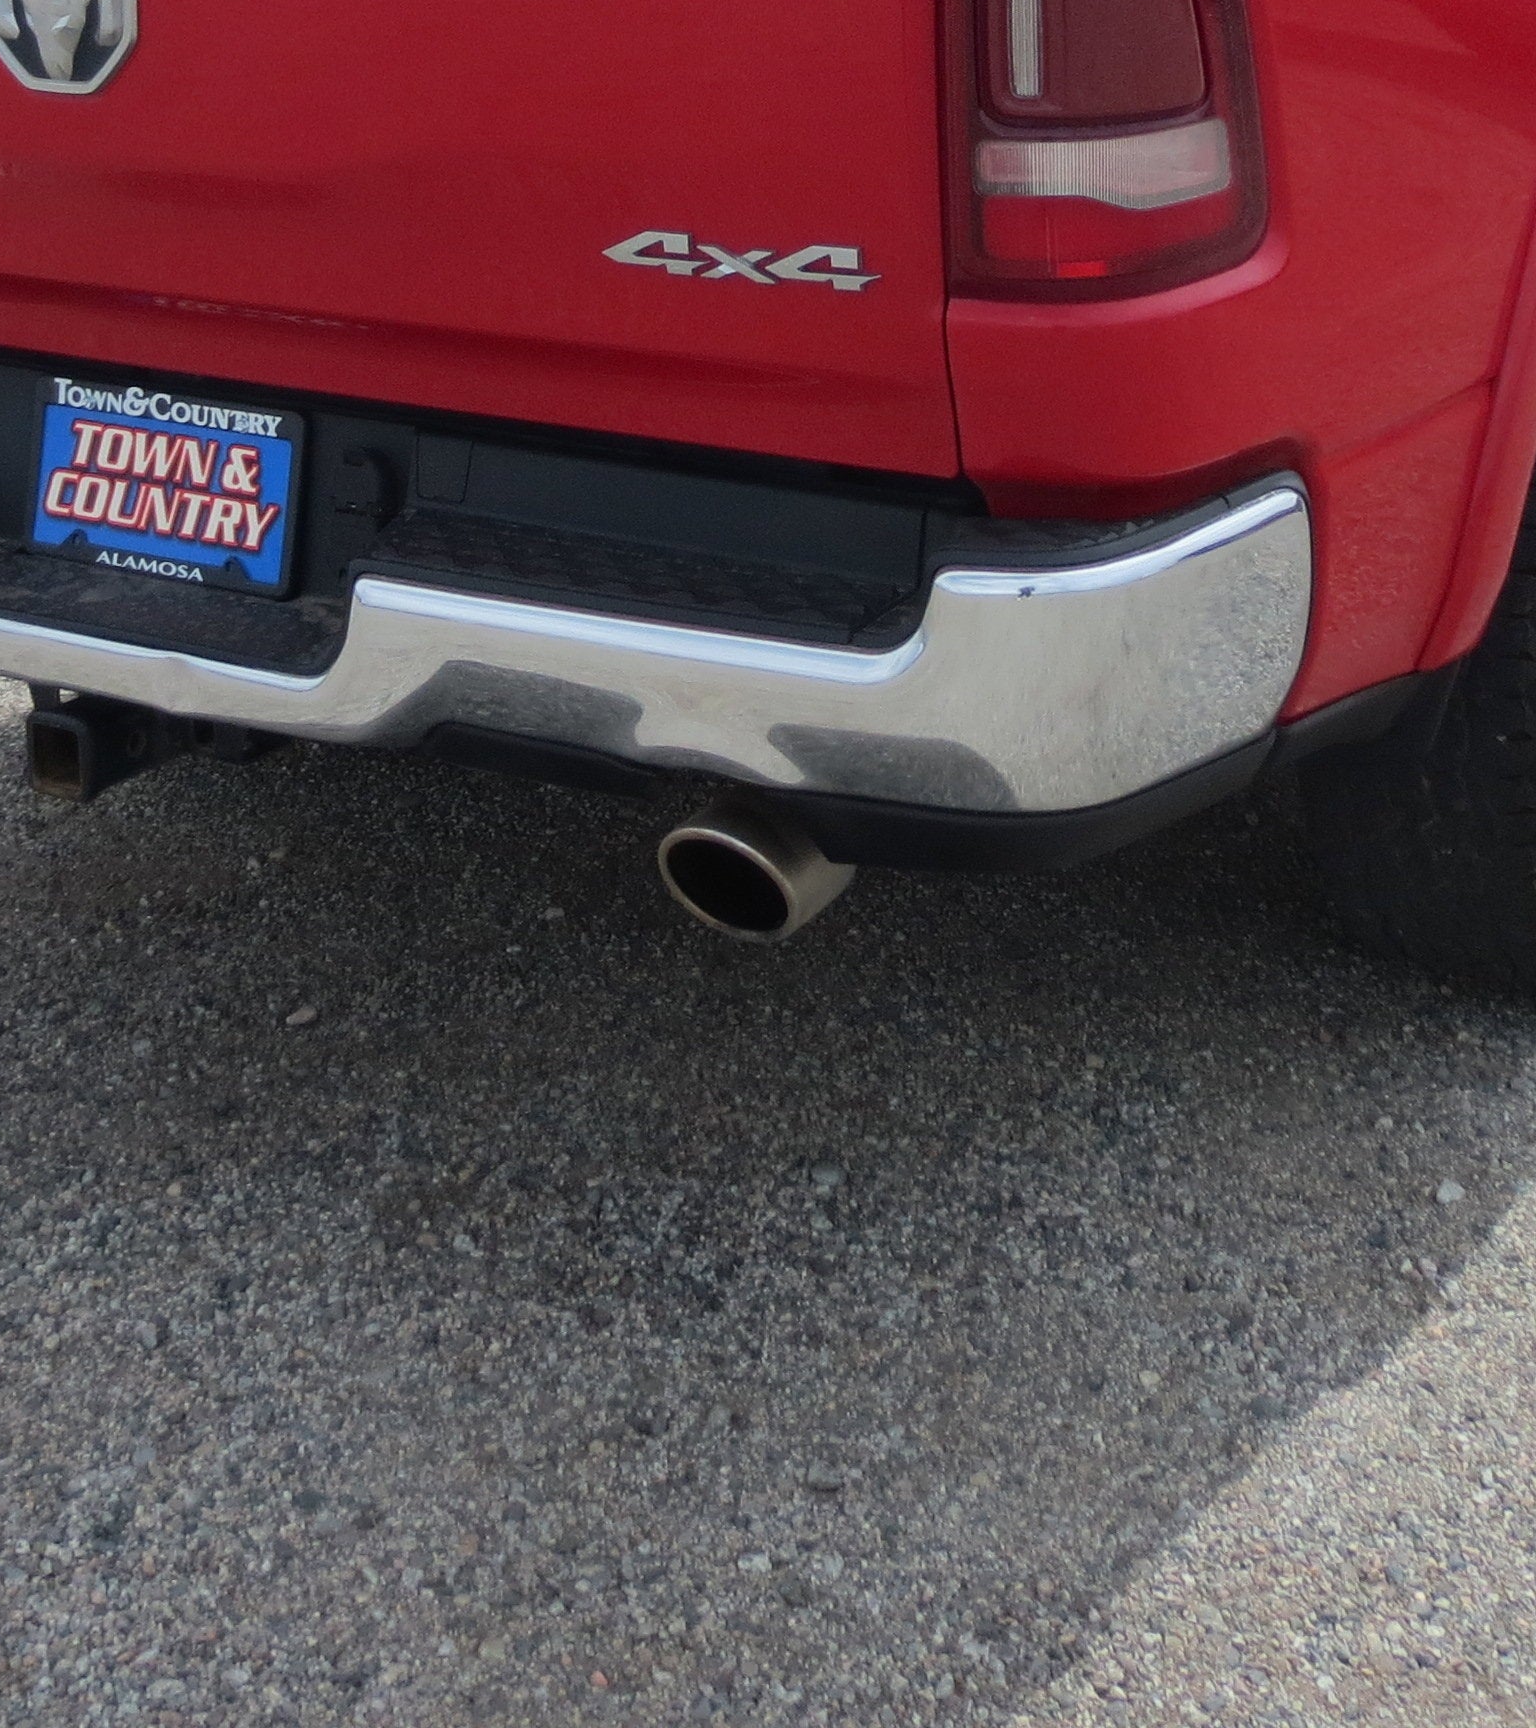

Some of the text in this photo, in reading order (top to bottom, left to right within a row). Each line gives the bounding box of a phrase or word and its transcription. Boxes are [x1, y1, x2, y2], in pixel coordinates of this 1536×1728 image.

[70, 419, 261, 497] TOWN &
[44, 467, 281, 552] COUNTRY
[95, 550, 205, 583] ALAMOSA
